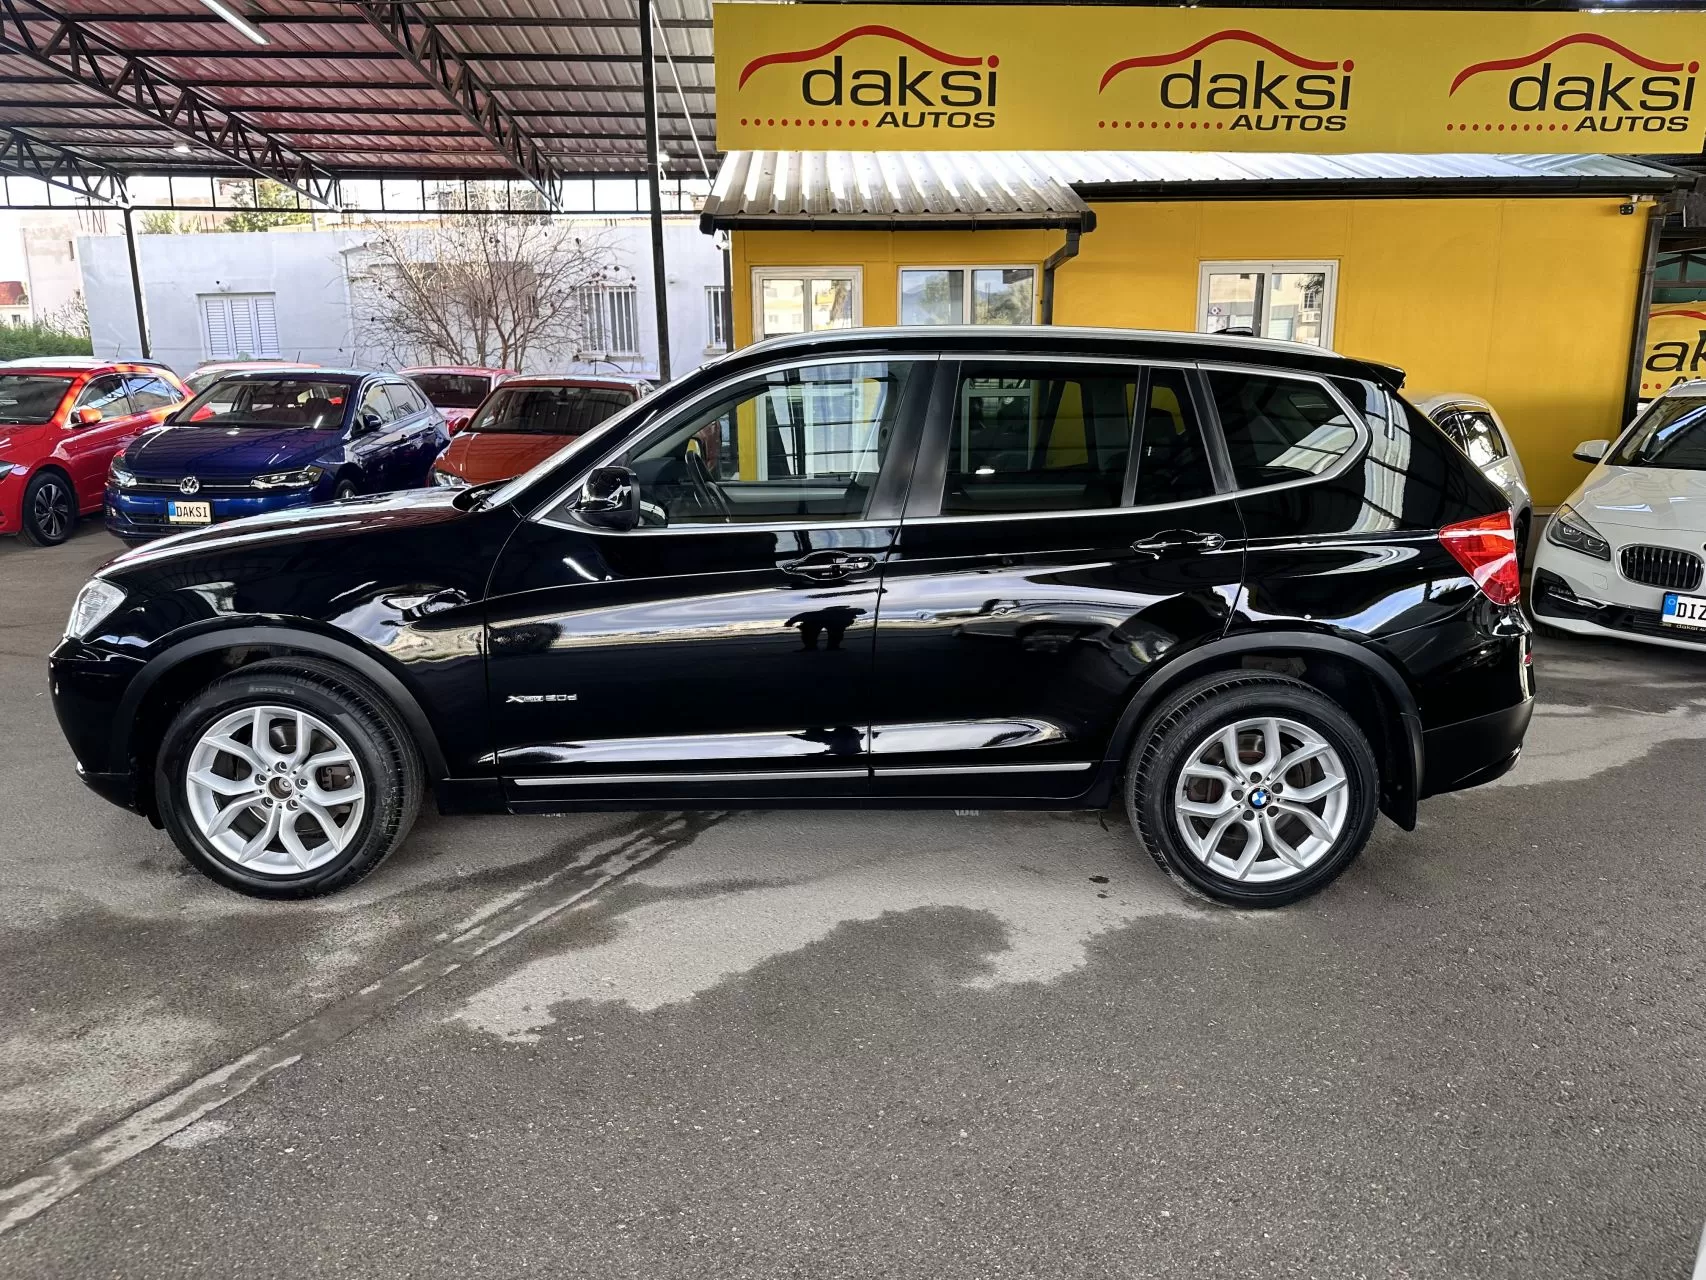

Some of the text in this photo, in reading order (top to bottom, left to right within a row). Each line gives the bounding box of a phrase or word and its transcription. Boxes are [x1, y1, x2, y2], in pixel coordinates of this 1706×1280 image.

[802, 54, 1000, 107] daksi
[1160, 59, 1355, 111] daksi
[1508, 60, 1700, 112] daksi
[875, 111, 996, 129] AUTOS
[1229, 114, 1347, 132] AUTOS
[1574, 116, 1689, 132] AUTOS
[176, 506, 208, 518] DAKSI
